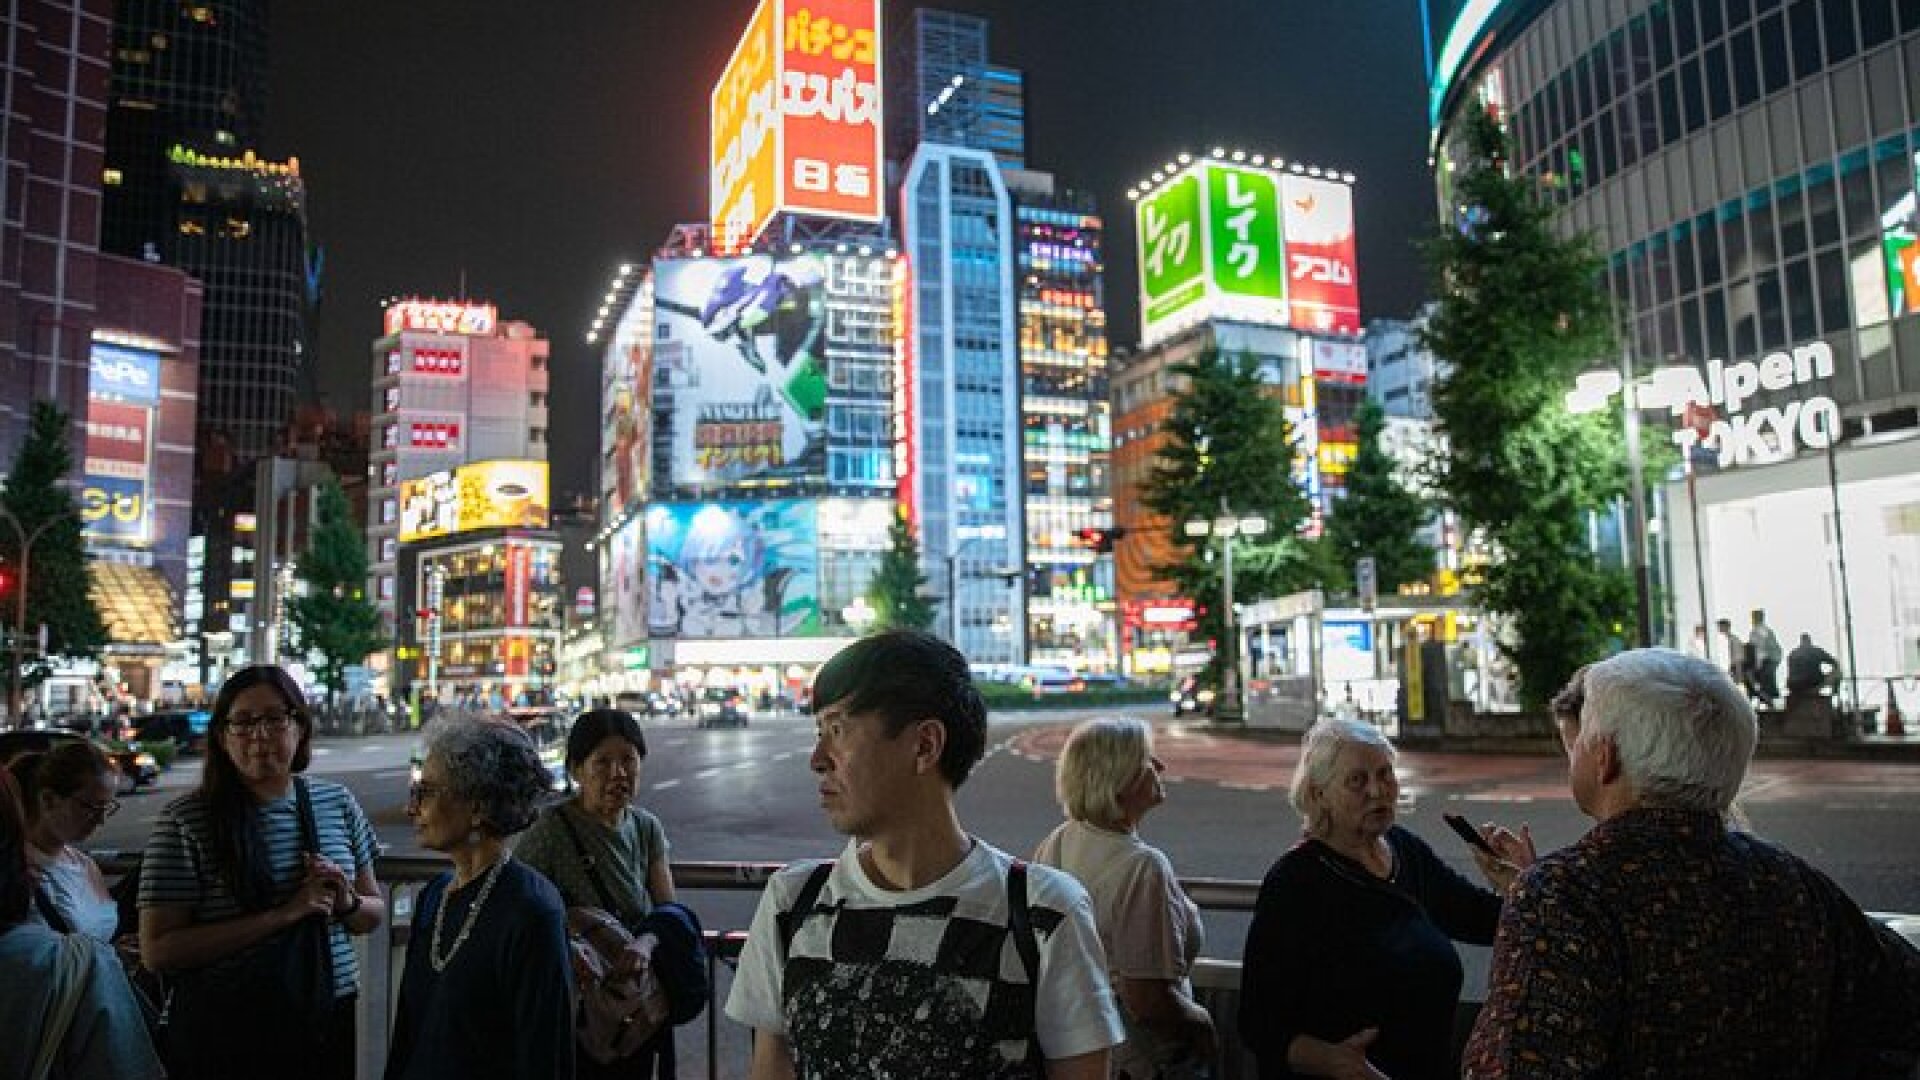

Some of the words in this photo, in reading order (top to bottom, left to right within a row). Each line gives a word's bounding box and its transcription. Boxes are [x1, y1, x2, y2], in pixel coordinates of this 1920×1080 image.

[784, 8, 876, 64] パチンコ
[783, 68, 881, 124] エスパス
[1225, 173, 1259, 278] レイク
[1290, 253, 1353, 286] アコム
[1671, 341, 1835, 418] Alpen
[1671, 396, 1843, 474] TOKYO
